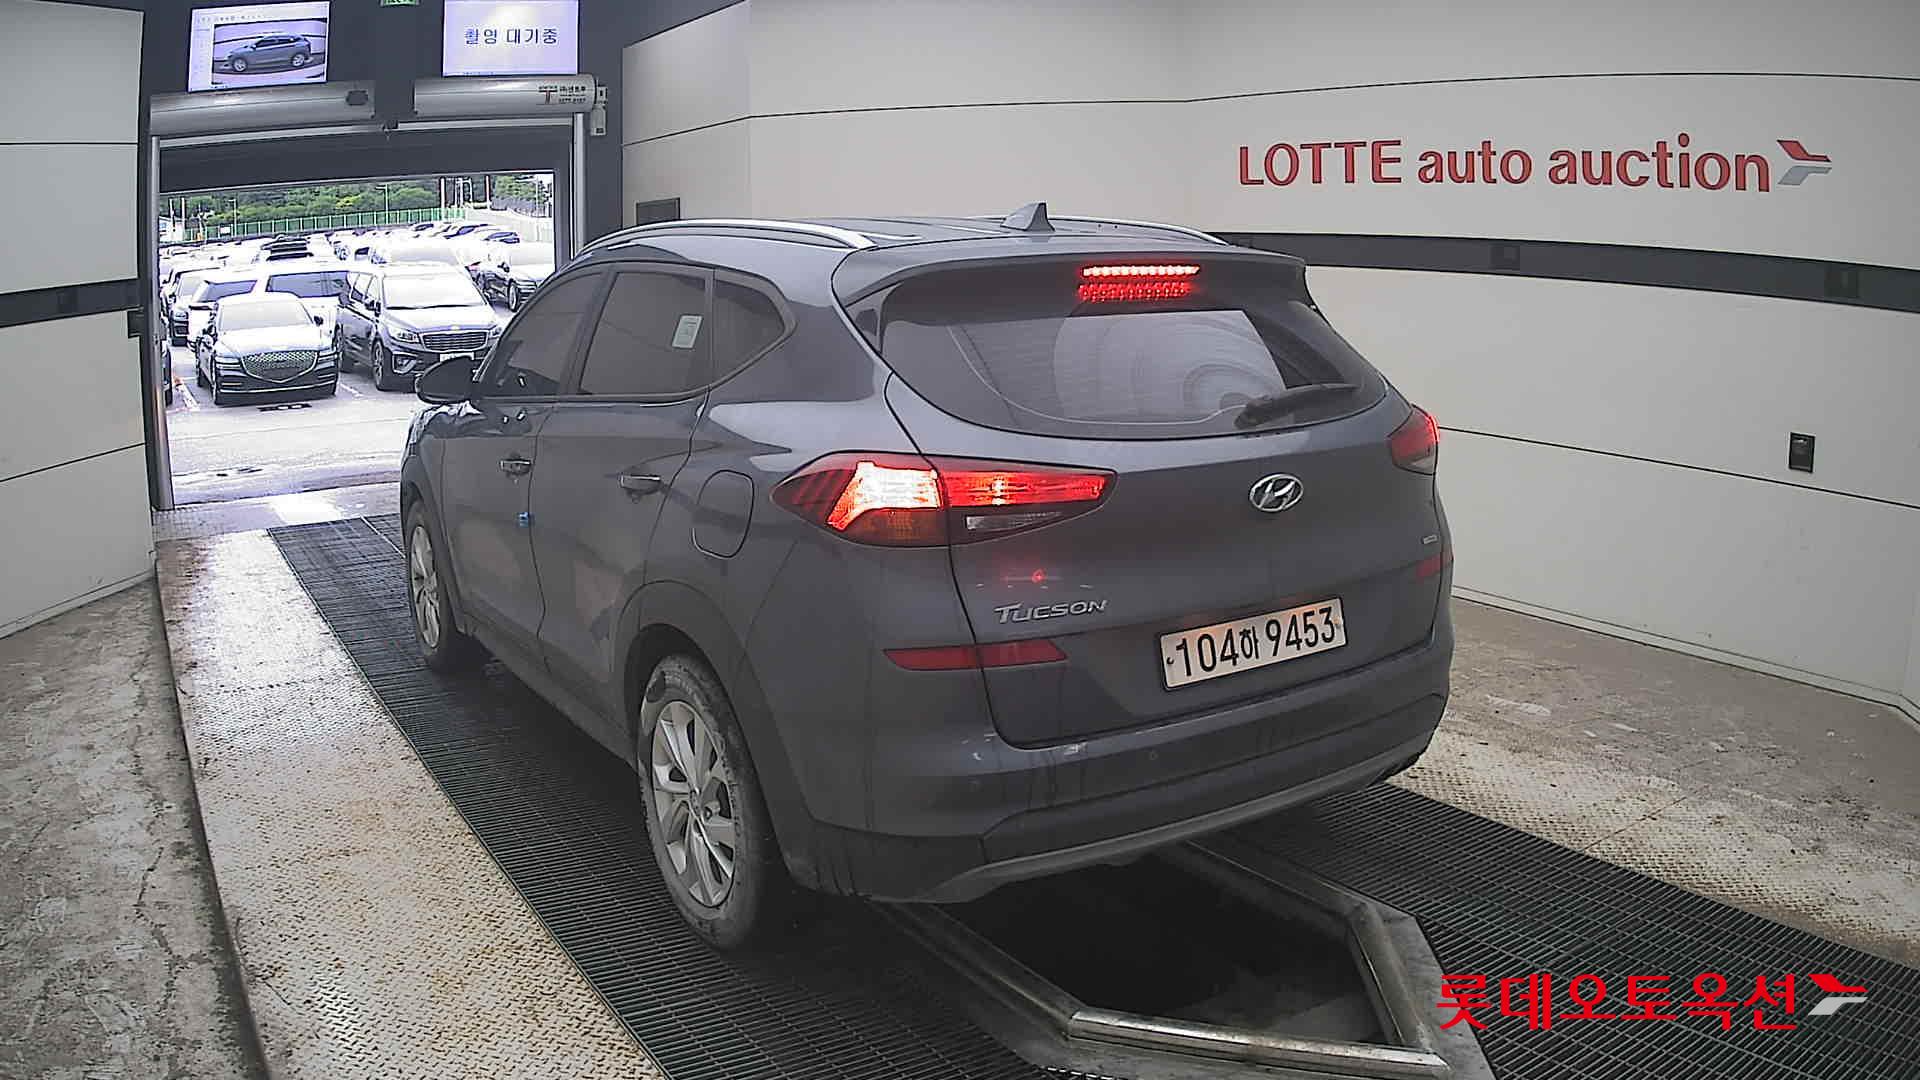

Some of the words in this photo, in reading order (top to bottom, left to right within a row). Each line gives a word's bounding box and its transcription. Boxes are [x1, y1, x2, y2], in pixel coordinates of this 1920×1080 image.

[506, 28, 558, 45] 대기중
[1239, 139, 1402, 187] LOTTE
[1417, 140, 1533, 186] auto
[1547, 132, 1771, 193] auction
[1175, 625, 1260, 677] 104하
[1264, 606, 1337, 657] 9453
